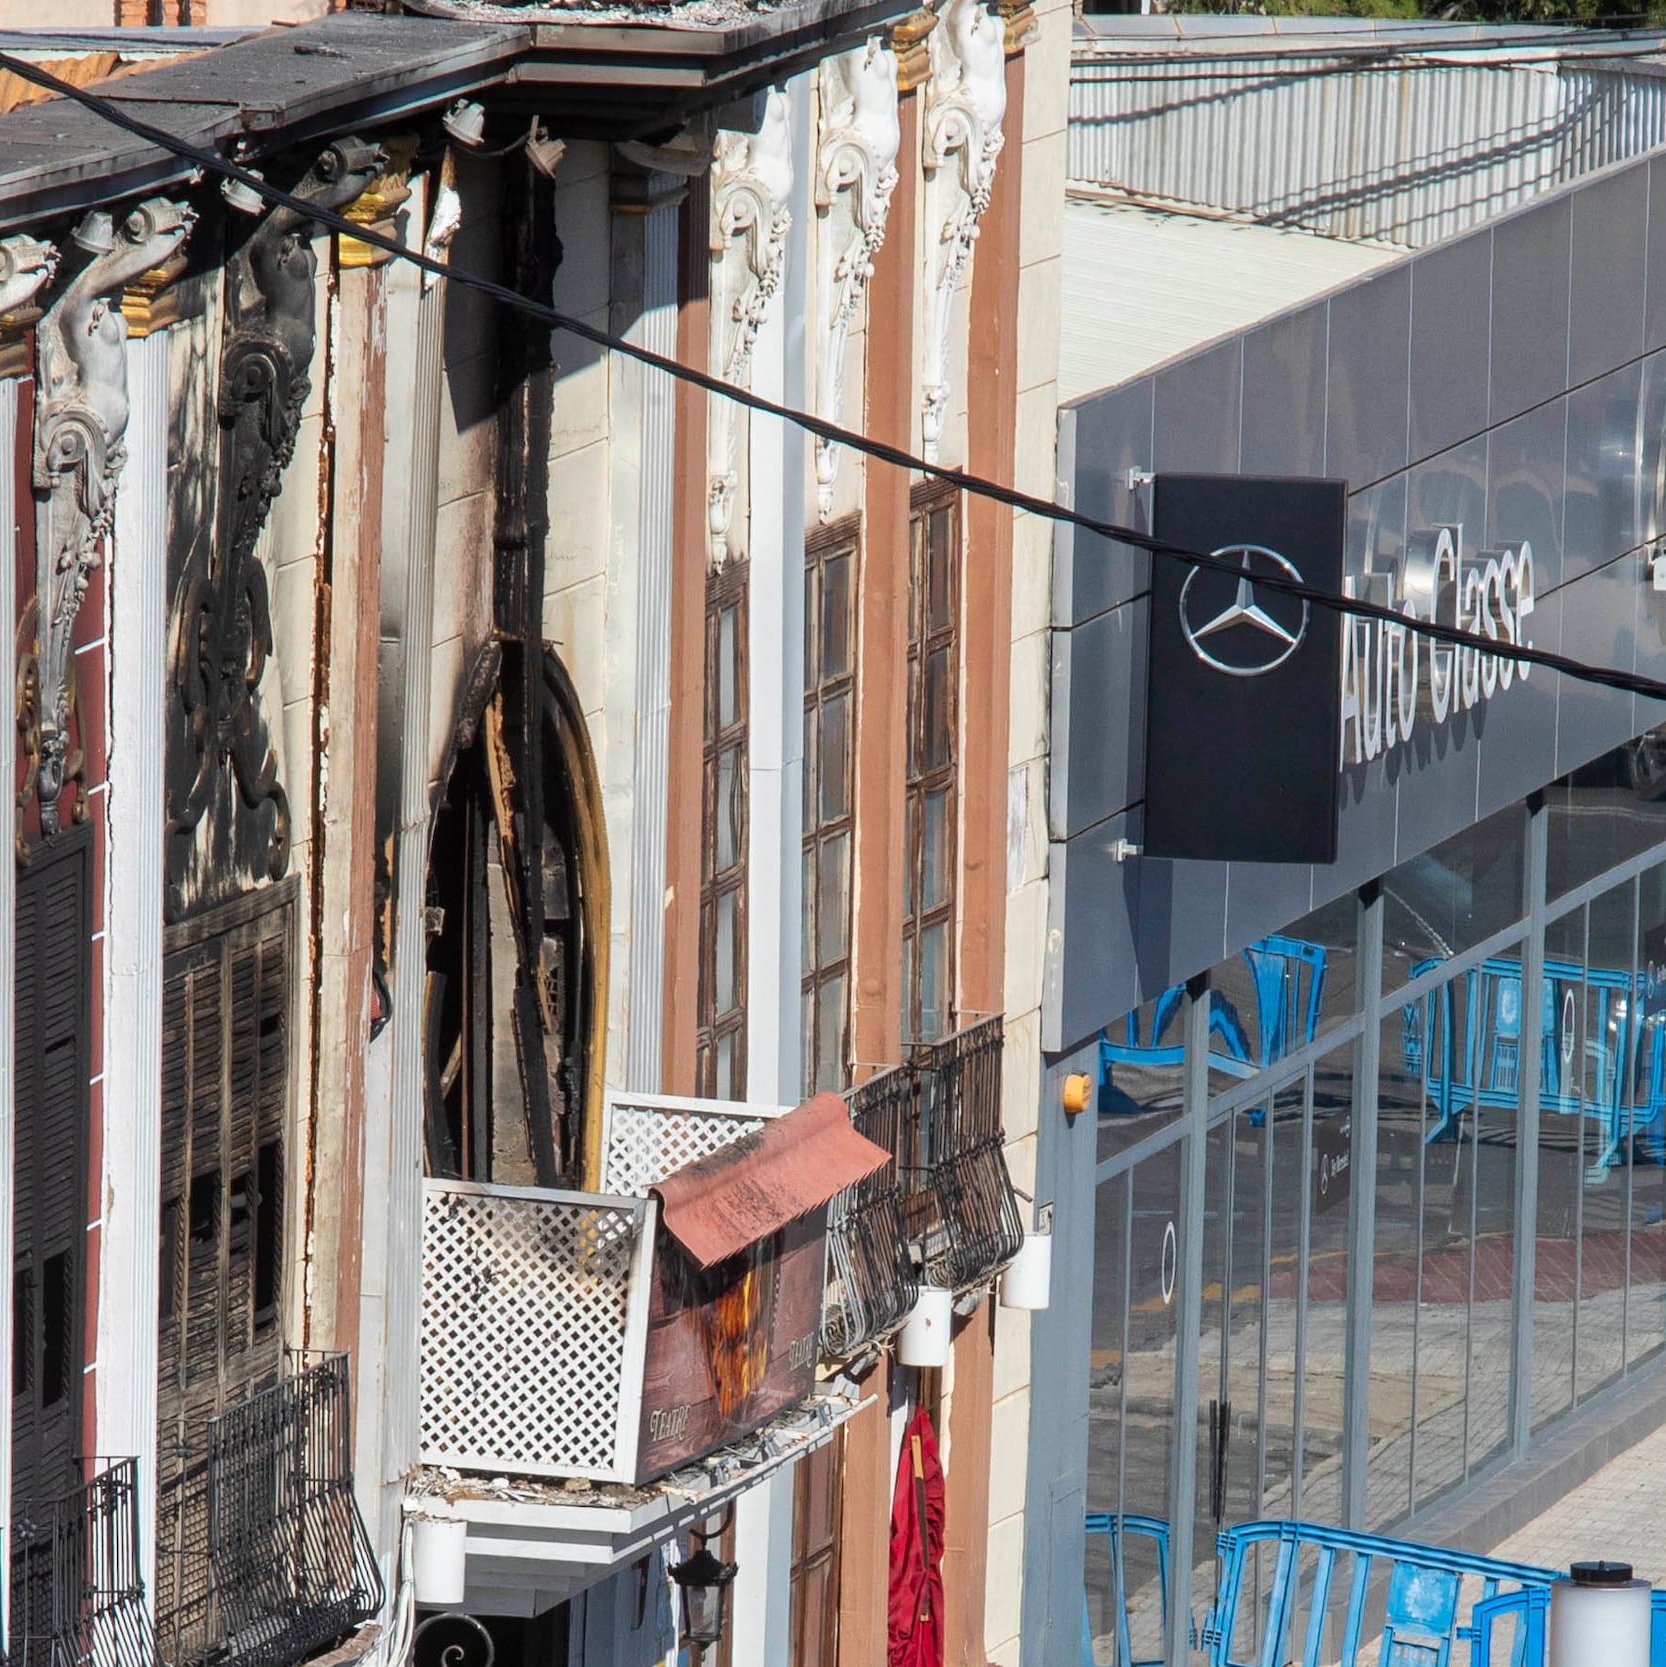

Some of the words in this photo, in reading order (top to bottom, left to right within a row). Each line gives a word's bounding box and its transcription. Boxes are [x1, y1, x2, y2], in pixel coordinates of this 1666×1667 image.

[1339, 572, 1419, 774] Auto
[1430, 523, 1535, 725] Classe
[650, 1405, 691, 1442] TEATRE
